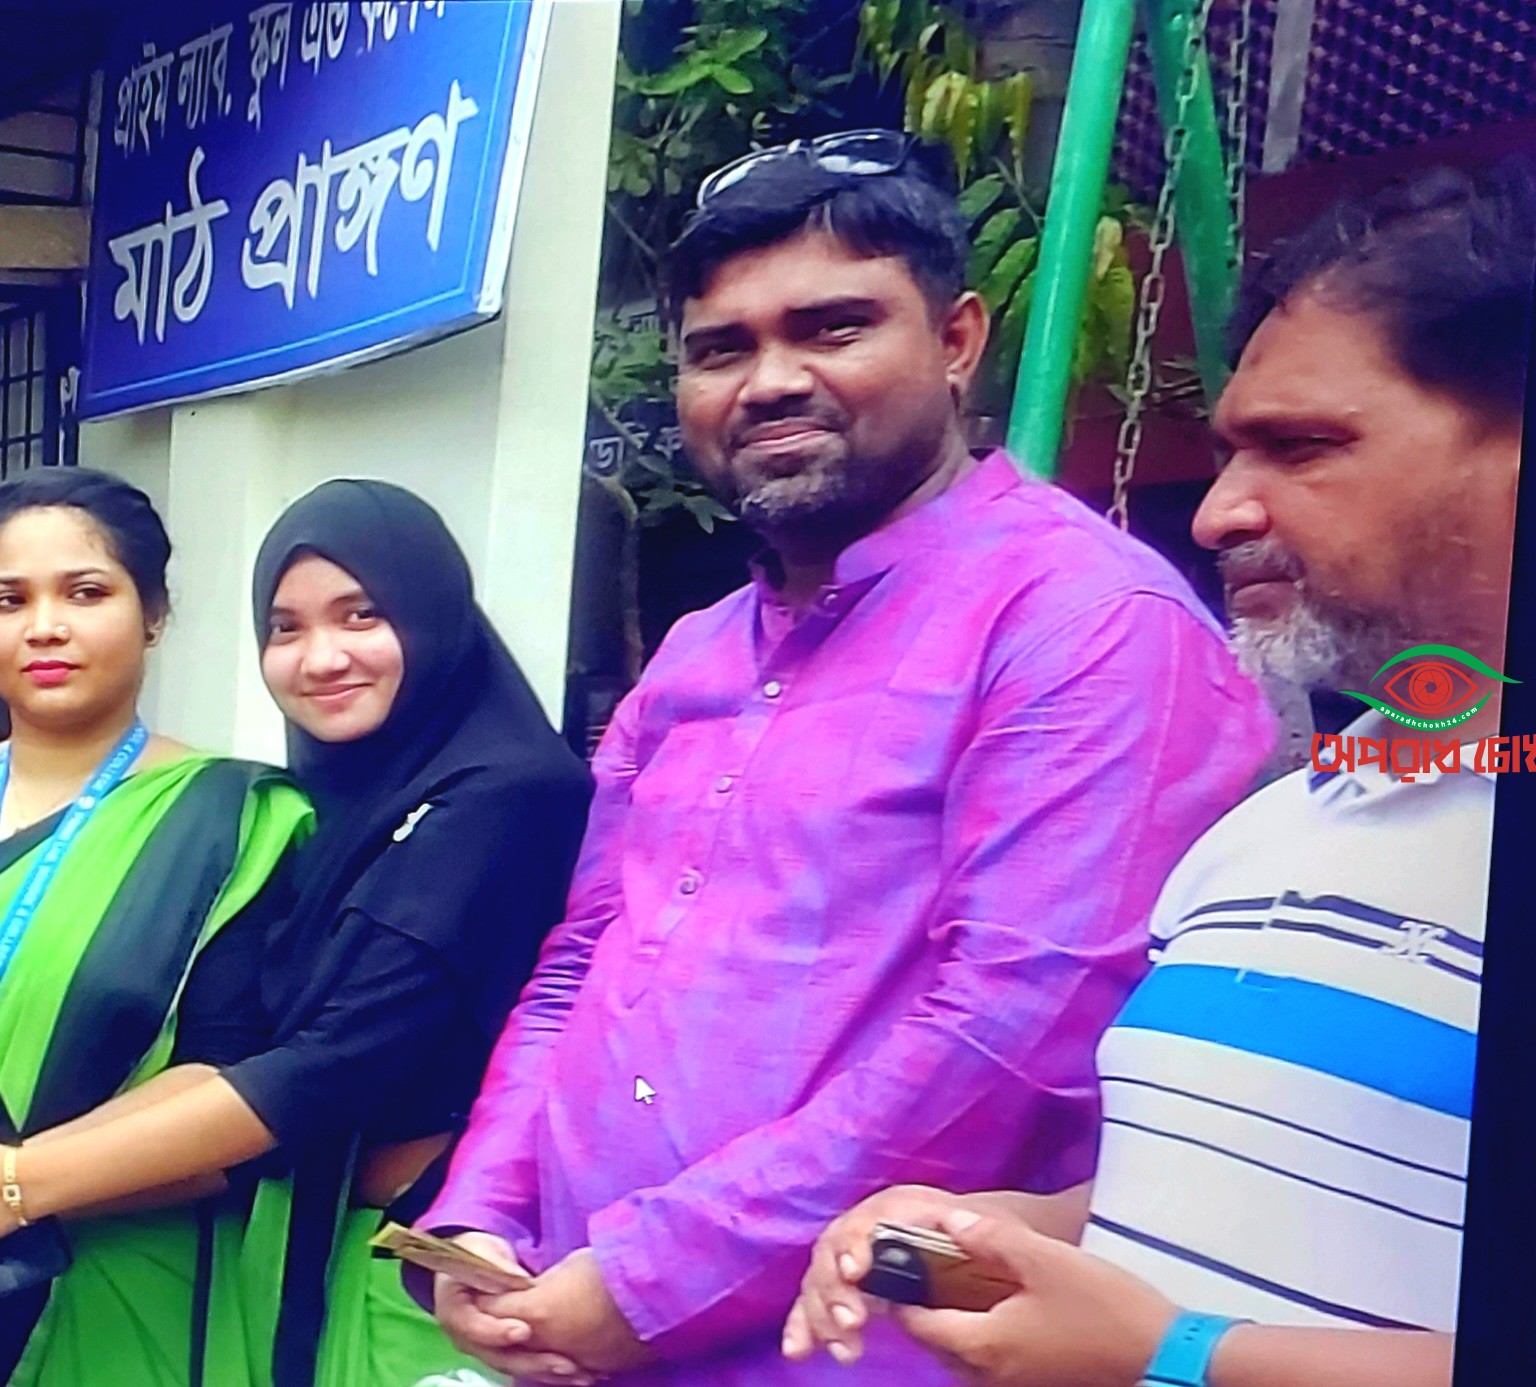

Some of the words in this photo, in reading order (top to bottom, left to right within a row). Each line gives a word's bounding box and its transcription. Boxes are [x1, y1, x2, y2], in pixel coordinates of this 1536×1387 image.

[114, 42, 175, 159] প্রাইম
[109, 146, 230, 345] মাঠ
[241, 78, 480, 310] প্রাঙ্গণ
